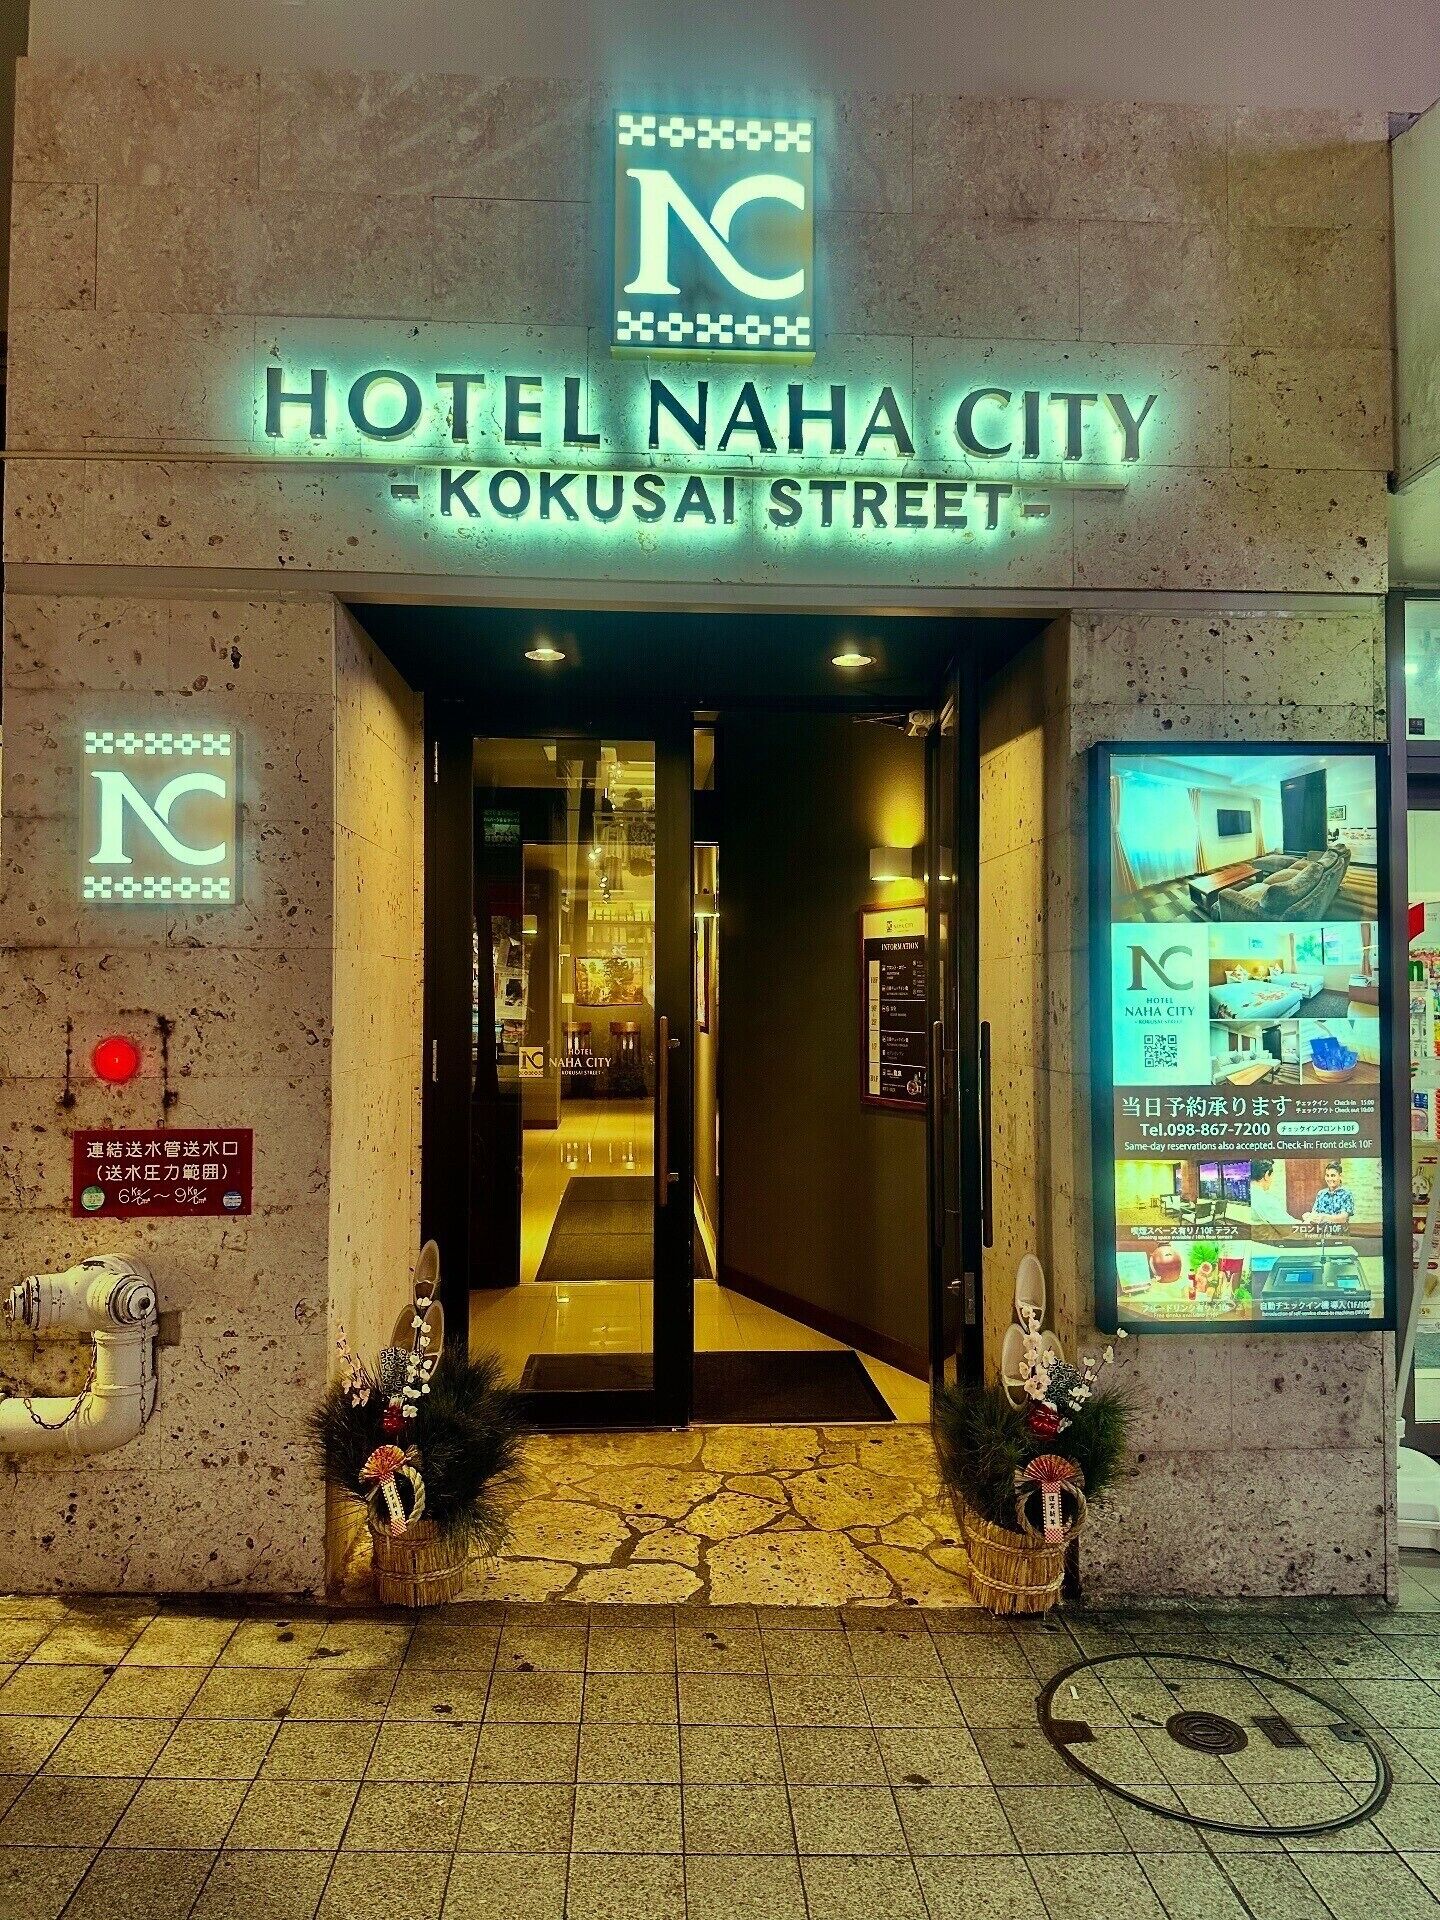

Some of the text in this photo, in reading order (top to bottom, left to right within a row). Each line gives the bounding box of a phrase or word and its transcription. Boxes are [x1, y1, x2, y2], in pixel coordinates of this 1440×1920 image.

[624, 169, 805, 300] NC
[265, 367, 1158, 462] HOTEL NAHA CITY
[440, 468, 735, 525] KOKUSAI
[769, 478, 1013, 531] STREET
[89, 771, 226, 865] NC
[1126, 945, 1193, 990] NC
[1125, 1006, 1195, 1016] NAHA CITY
[549, 1057, 612, 1068] NAHA CITY
[1122, 1095, 1292, 1117] 当日予約承ります
[1140, 1122, 1271, 1137] Tel.098-867-7200
[87, 1140, 238, 1158] 連結送水管送水口
[1124, 1141, 1166, 1152] Same-day
[1167, 1141, 1217, 1151] reservations
[1218, 1141, 1235, 1151] also
[1235, 1140, 1275, 1152] accepted.
[1316, 1140, 1337, 1149] Front
[1338, 1139, 1357, 1149] desk
[1359, 1140, 1373, 1149] 10F
[1215, 1226, 1239, 1234] テラス
[1292, 1225, 1322, 1234] フロント
